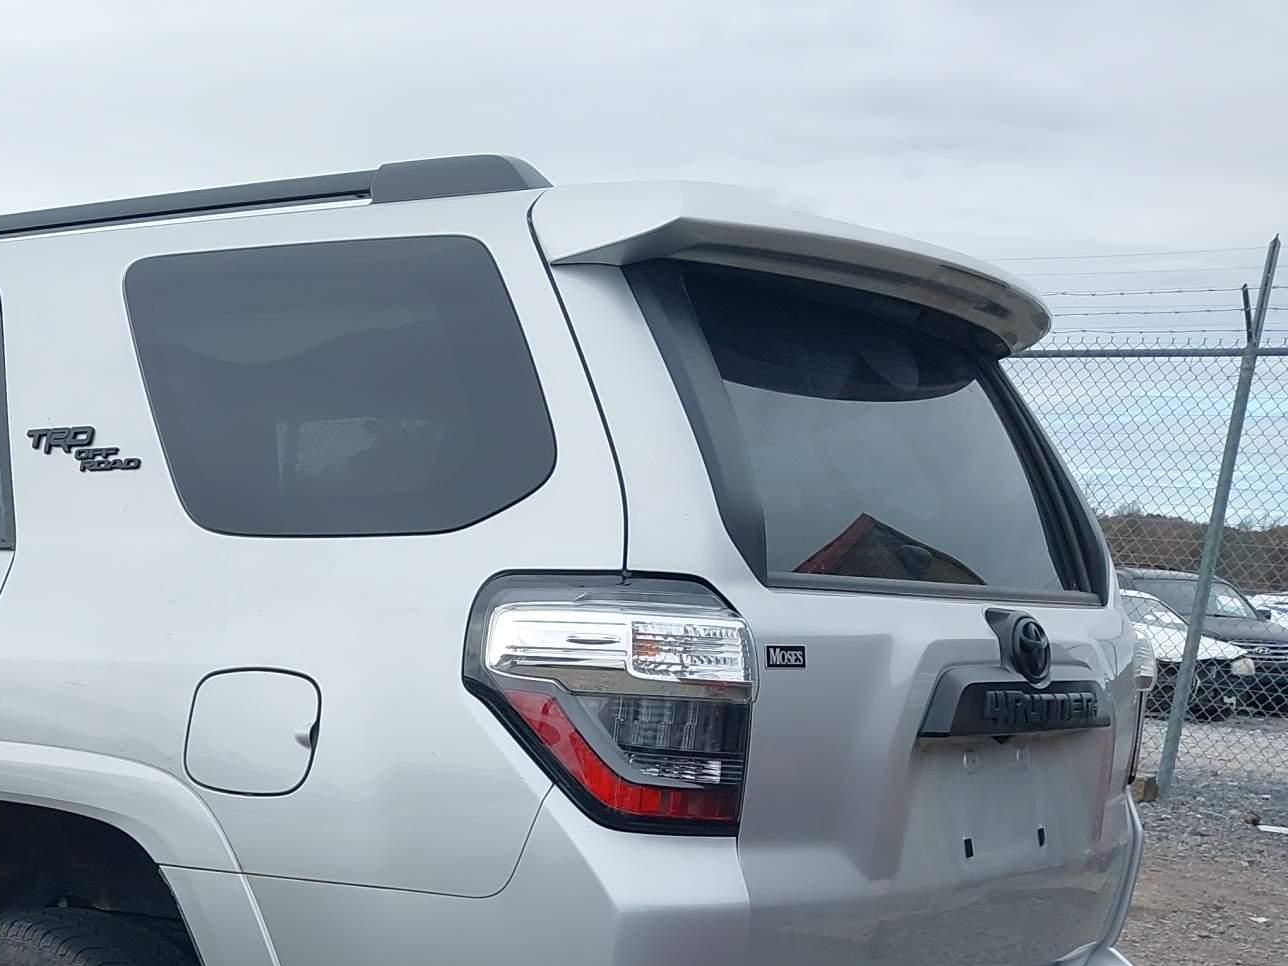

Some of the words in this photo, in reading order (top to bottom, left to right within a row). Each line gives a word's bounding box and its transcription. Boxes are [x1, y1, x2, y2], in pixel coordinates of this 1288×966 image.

[27, 426, 95, 454] TRD
[75, 447, 120, 461] OFF
[79, 458, 141, 473] ROAD
